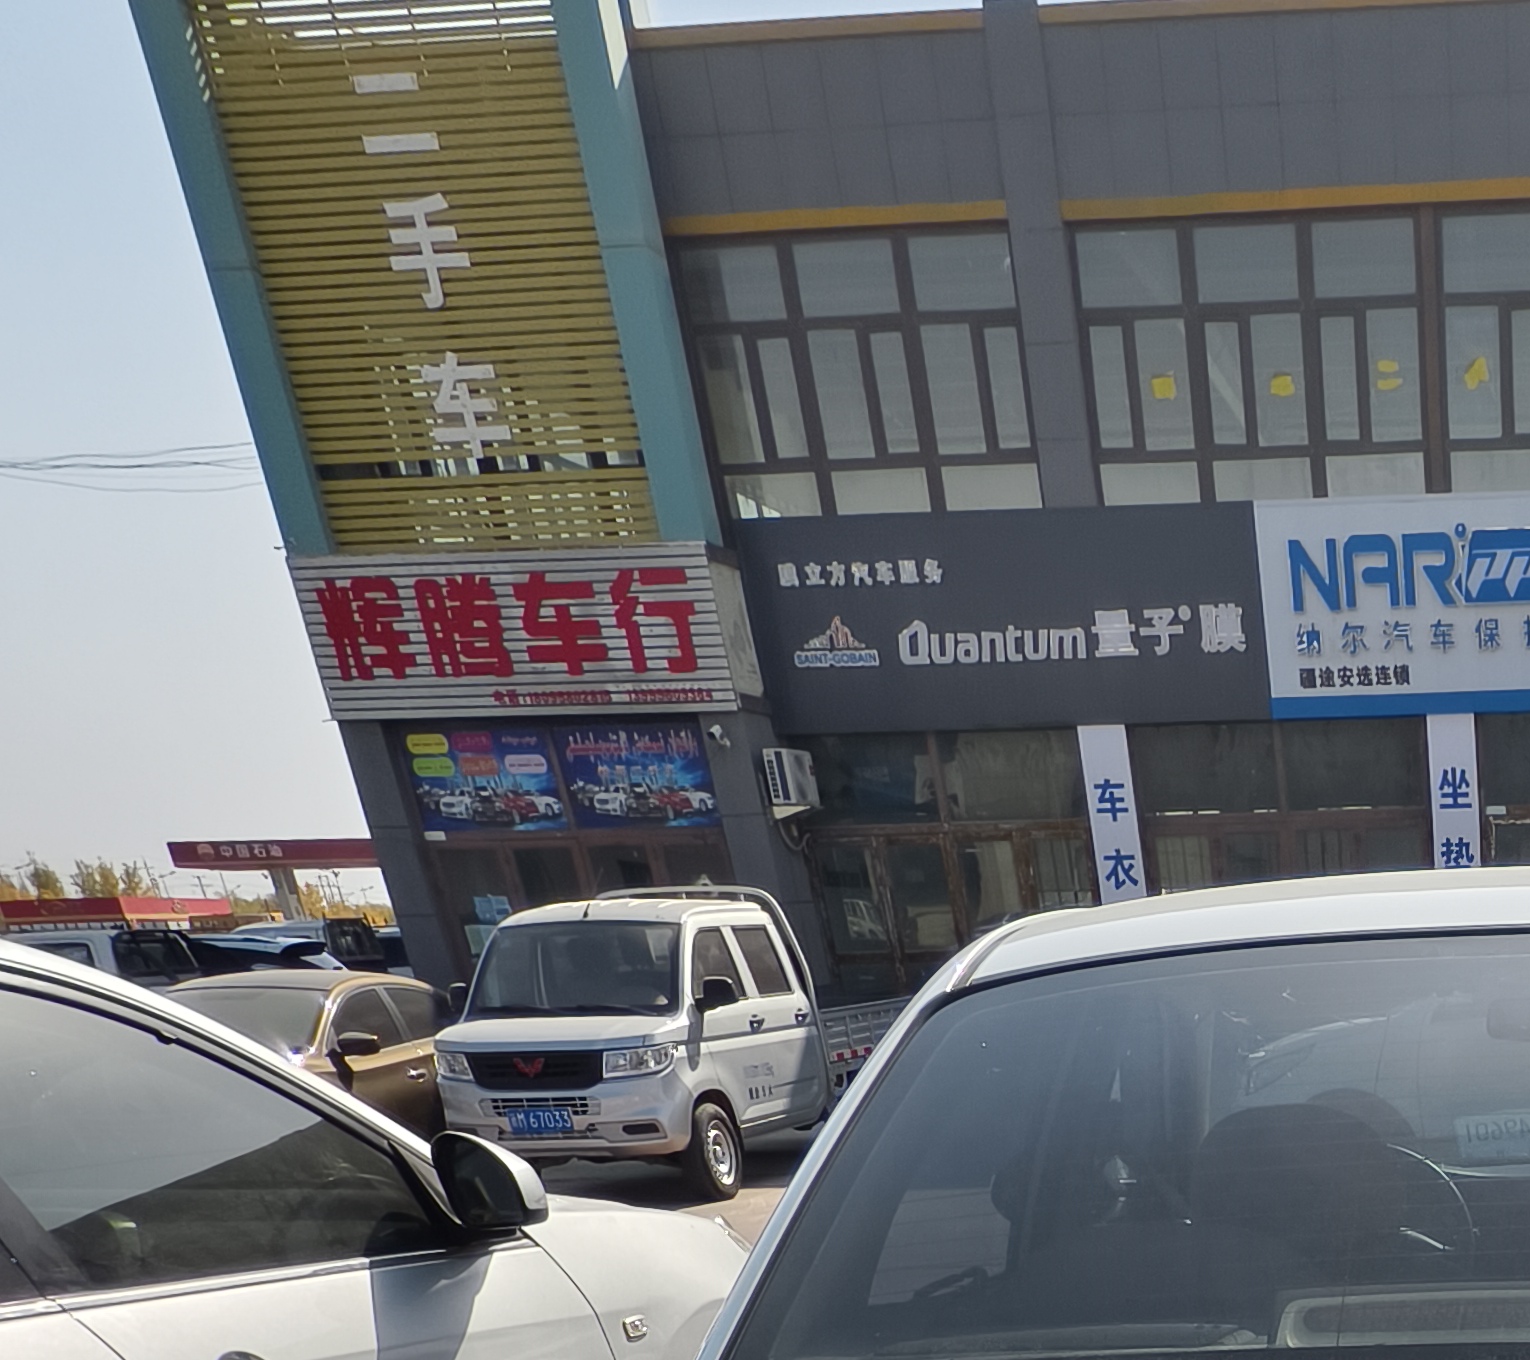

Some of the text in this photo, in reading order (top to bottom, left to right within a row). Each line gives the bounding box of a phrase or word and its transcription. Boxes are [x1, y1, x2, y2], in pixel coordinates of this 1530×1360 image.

[353, 71, 512, 459] 二手车
[316, 567, 698, 681] 辉腾车行
[795, 652, 877, 666] SAINT-GOBAIN
[898, 619, 1087, 666] Quantum
[219, 843, 283, 858] 中国石油
[1094, 779, 1138, 890] 车衣
[1438, 767, 1474, 867] 坐垫
